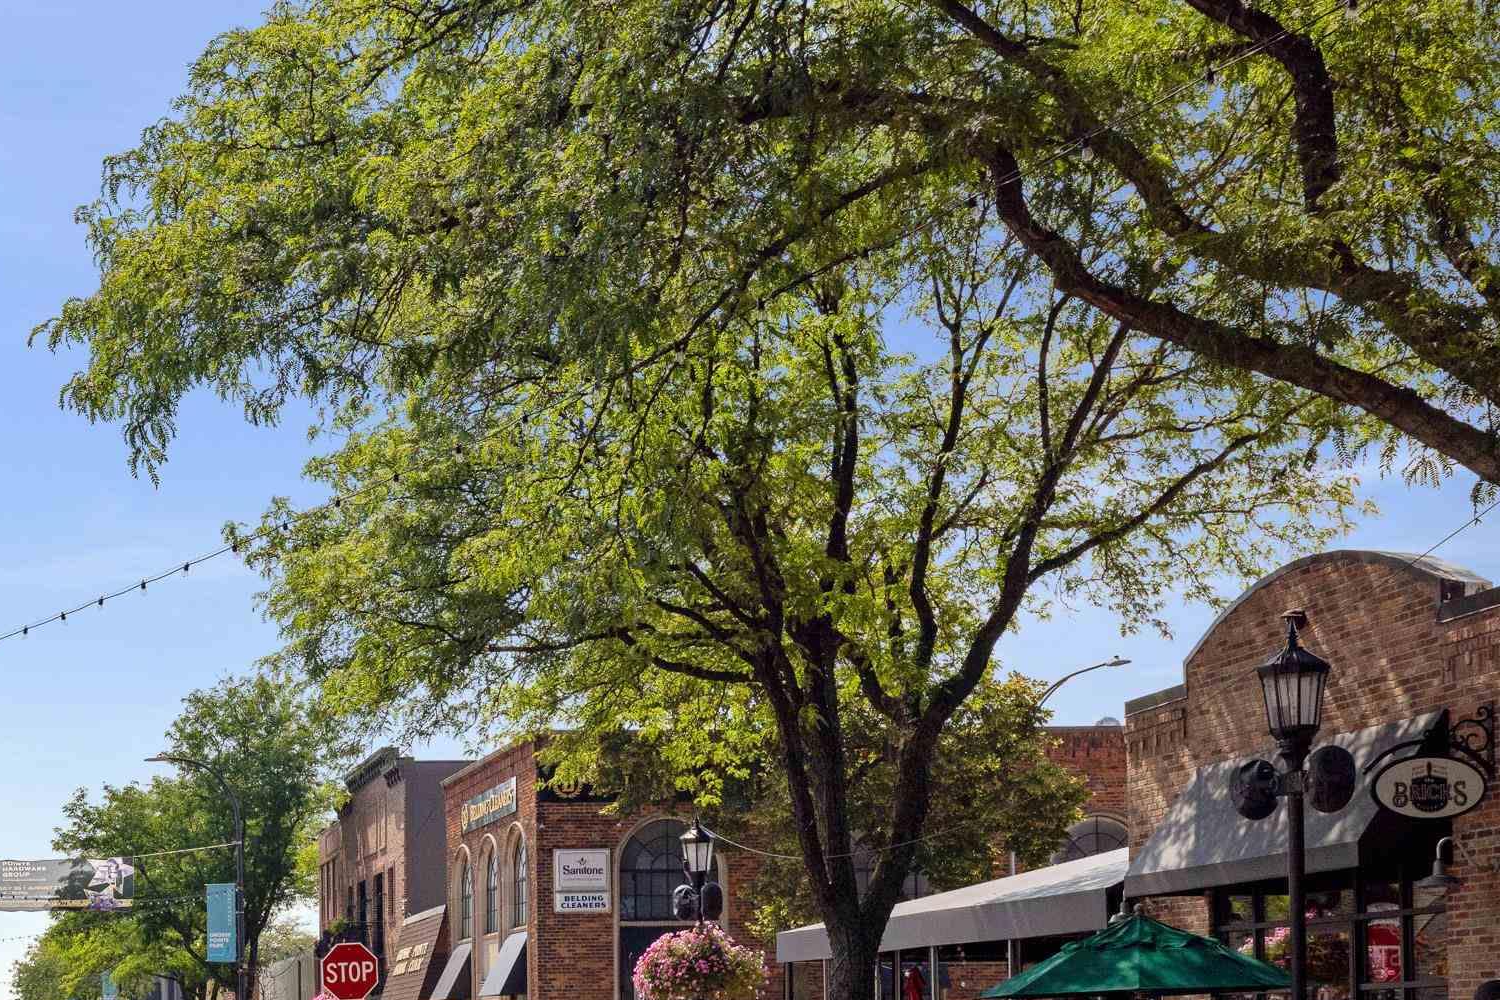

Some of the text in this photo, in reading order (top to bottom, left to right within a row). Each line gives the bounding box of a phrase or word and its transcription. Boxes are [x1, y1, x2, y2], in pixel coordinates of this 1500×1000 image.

[1393, 781, 1468, 808] BRICKS
[563, 864, 604, 875] Sanitone
[326, 961, 374, 984] STOP
